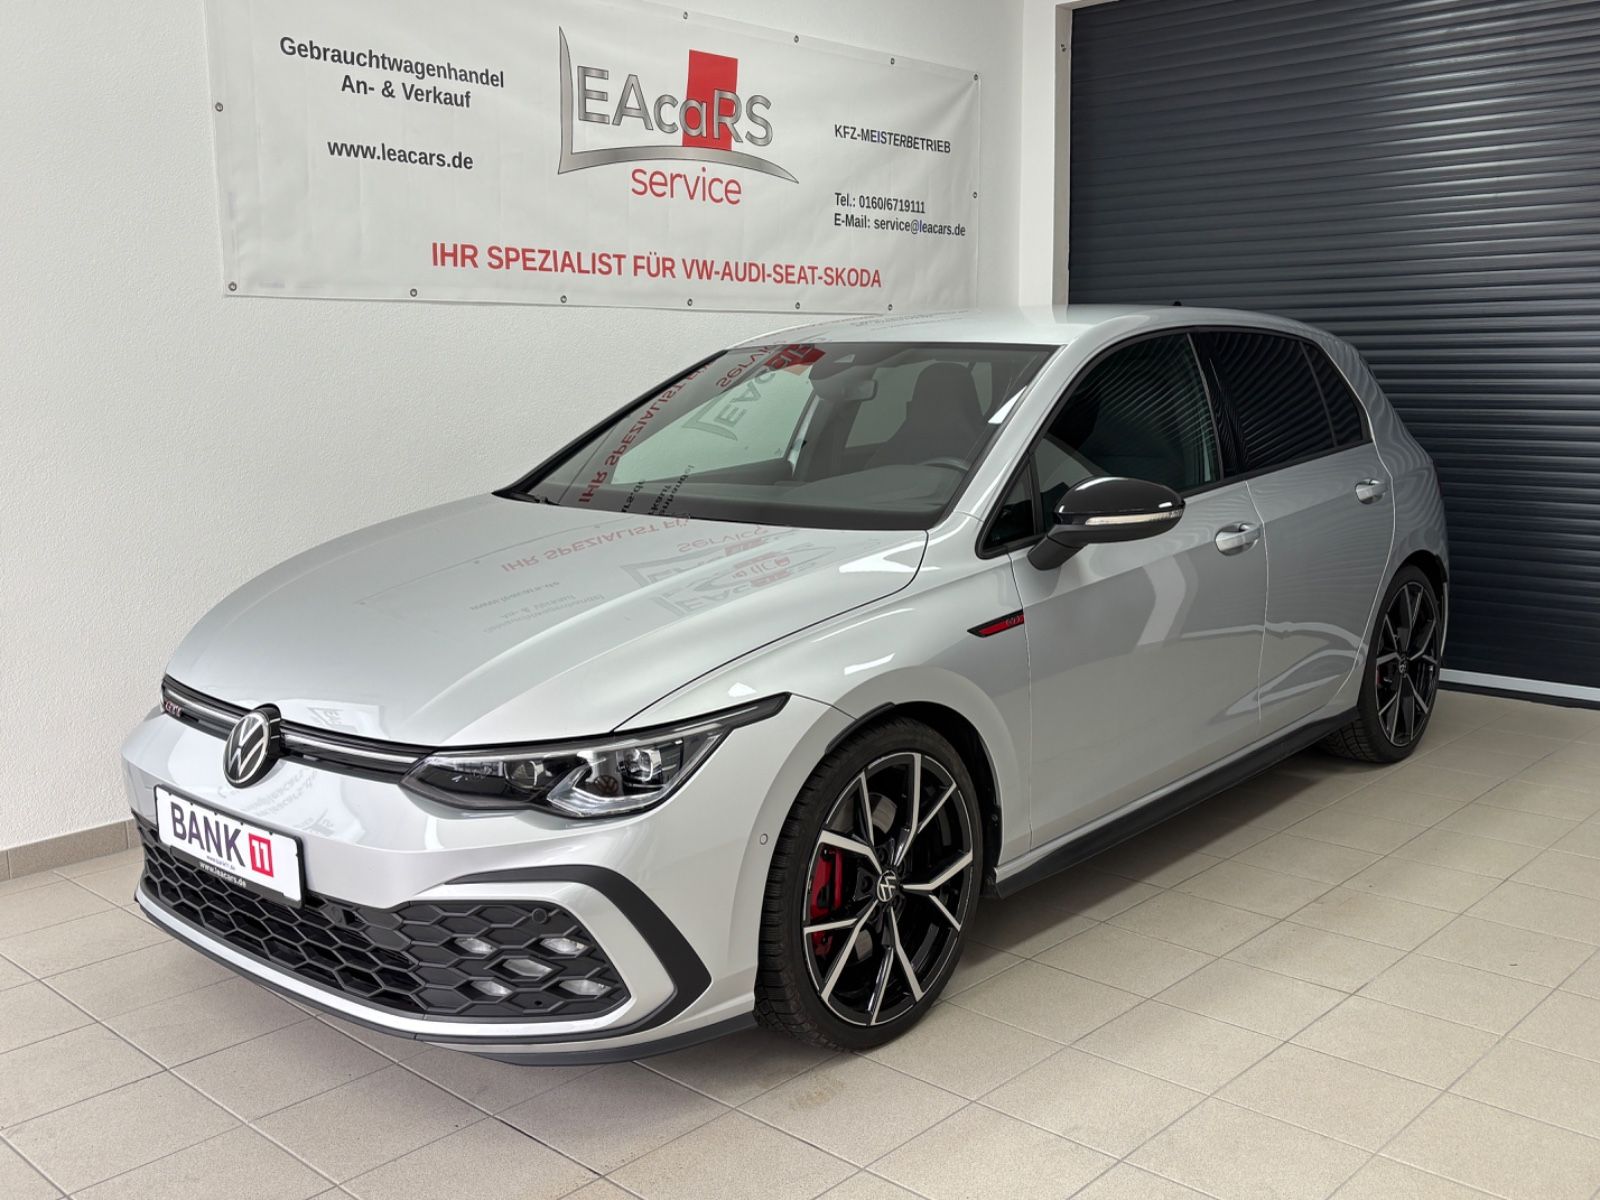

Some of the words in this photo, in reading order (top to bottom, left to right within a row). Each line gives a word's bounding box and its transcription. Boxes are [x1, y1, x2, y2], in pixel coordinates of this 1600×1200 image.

[279, 36, 504, 88] Gebrauchtwagenhandel
[341, 75, 375, 96] An-
[381, 80, 396, 98] &
[402, 83, 471, 108] Verkauf
[327, 140, 474, 170] www.leacars.de
[834, 124, 951, 154] KFZ-MEISTERBETRIEB
[631, 166, 742, 205] service
[834, 192, 856, 208] Tel.:
[858, 197, 926, 215] 0160/6719111
[834, 213, 871, 229] E-Mail:
[873, 218, 966, 238] service@leacars.de
[431, 242, 479, 268] IHR
[486, 245, 627, 278] SPEZIALIST
[633, 251, 676, 280] FÜR
[682, 257, 882, 289] VW-AUDI-SEAT-SKODA
[170, 801, 246, 868] BANK
